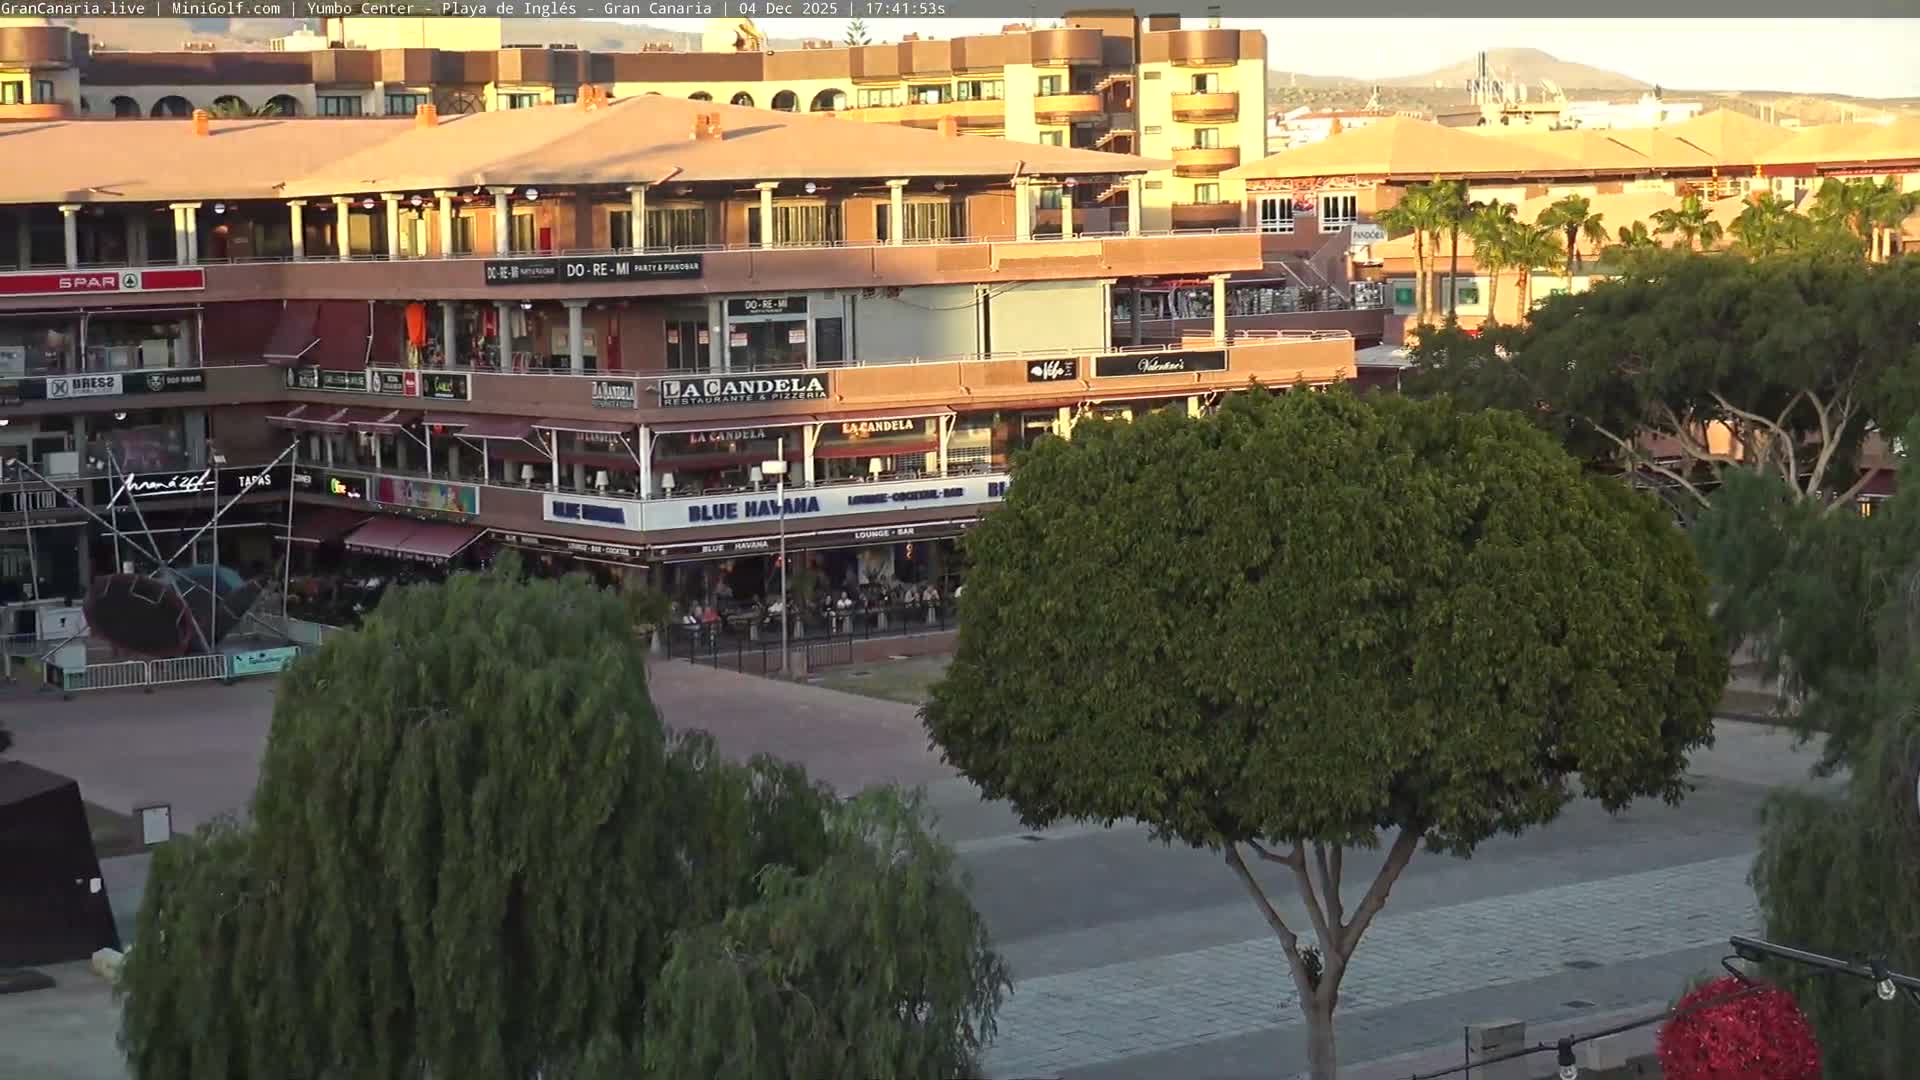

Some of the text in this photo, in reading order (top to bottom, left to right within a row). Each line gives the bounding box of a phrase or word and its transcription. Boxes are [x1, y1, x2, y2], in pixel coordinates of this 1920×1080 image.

[634, 263, 656, 273] PARTY
[59, 276, 116, 289] SPAR
[663, 377, 824, 399] LA CANDELA
[664, 394, 753, 406] RESTAURANTE
[771, 391, 827, 401] PIZZERIA
[841, 419, 914, 434] LA CANDELA
[709, 429, 767, 442] CANDELA
[240, 475, 272, 487] TAPAS
[688, 496, 820, 522] BLUE HAVANA
[855, 529, 890, 539] LOUNGE
[897, 527, 914, 536] BAR
[702, 541, 769, 553] BLUE HAVANA
